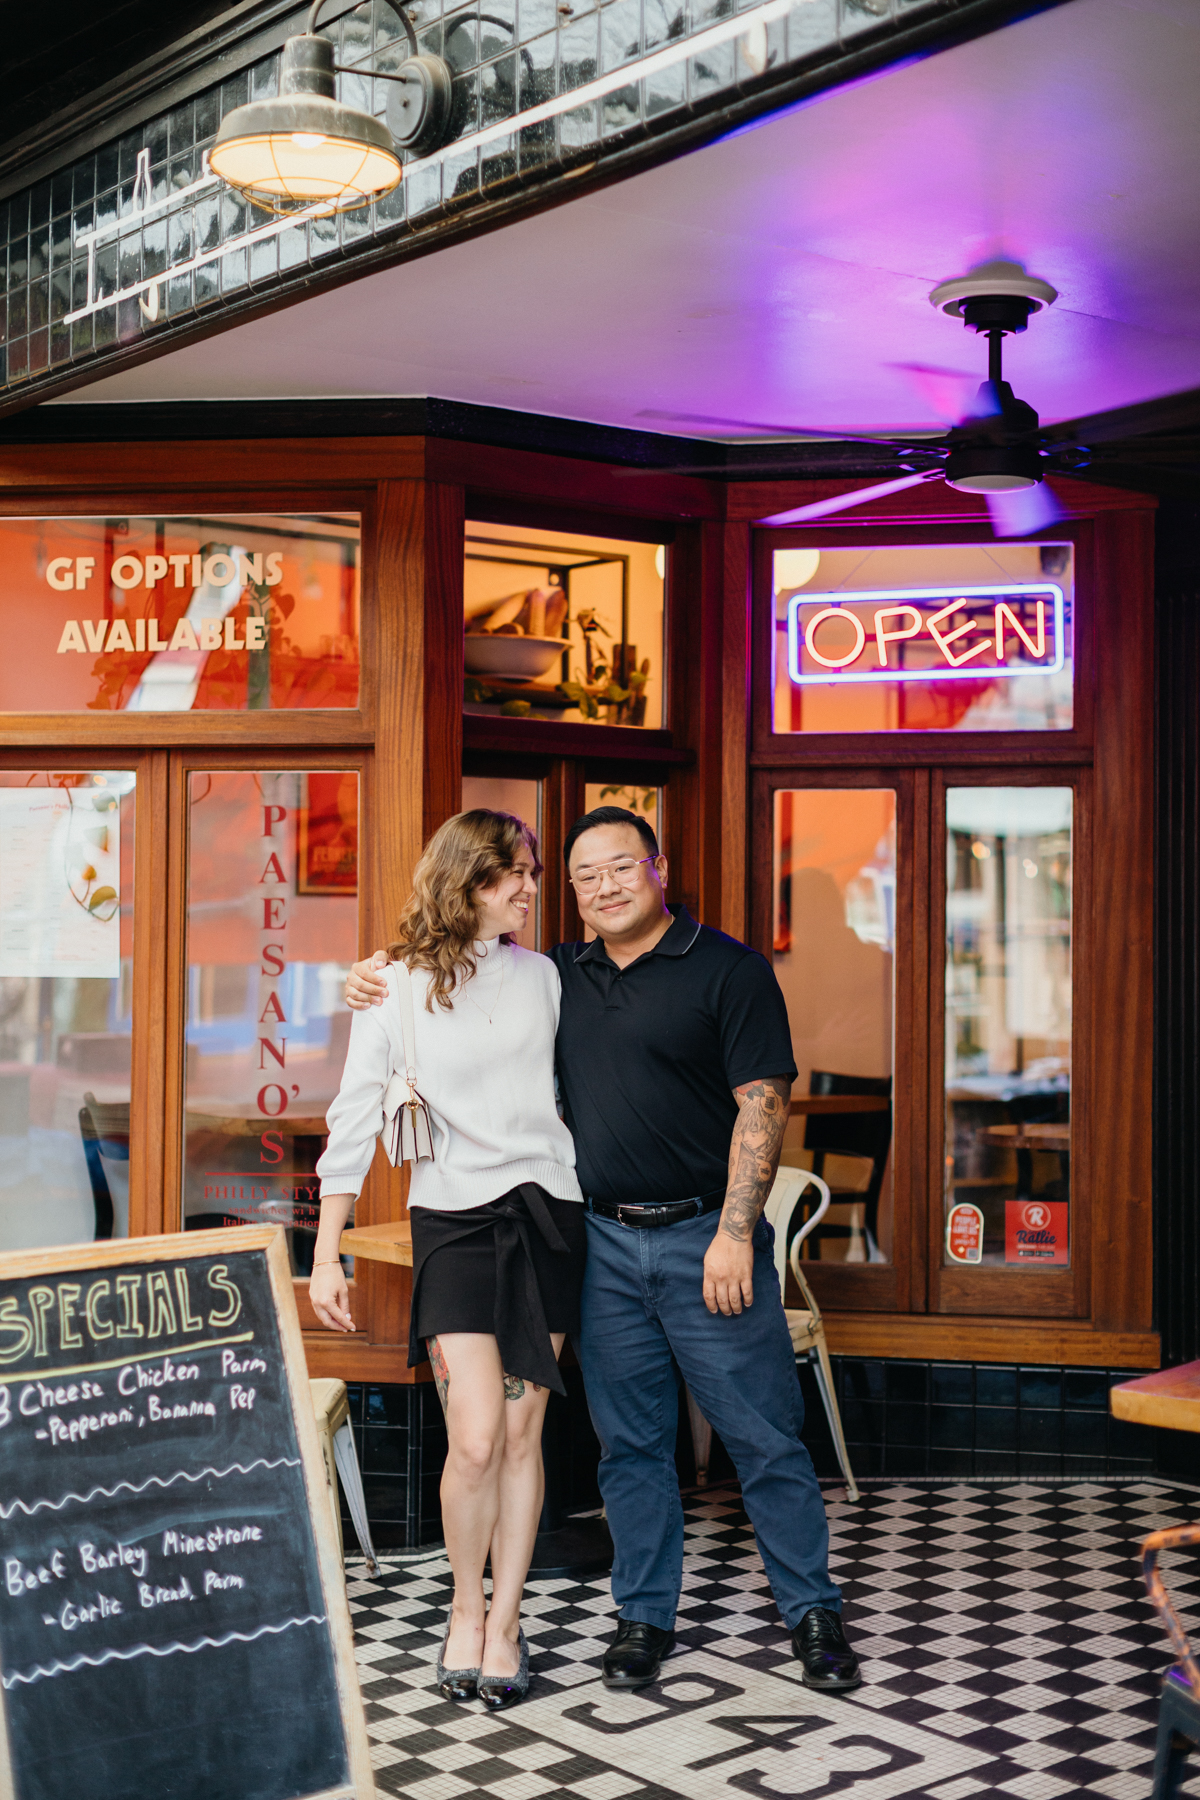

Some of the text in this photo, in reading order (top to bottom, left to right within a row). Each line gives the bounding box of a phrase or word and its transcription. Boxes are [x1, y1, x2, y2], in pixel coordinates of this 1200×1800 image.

[46, 552, 283, 591] GF OPTIONS
[57, 617, 267, 653] AVAILABLE
[804, 597, 1046, 668] OPEN
[204, 1185, 321, 1200] PHILLY STY
[228, 1204, 316, 1216] sandwiches wih
[0, 1264, 243, 1364] SPECIALS
[19, 1380, 104, 1416] Cheese
[118, 1357, 199, 1396] Chicken
[222, 1349, 267, 1377] Parm
[230, 1384, 256, 1410] Pep
[5, 1525, 263, 1596] Beef Barley Minestrone
[204, 1569, 246, 1596] Parm
